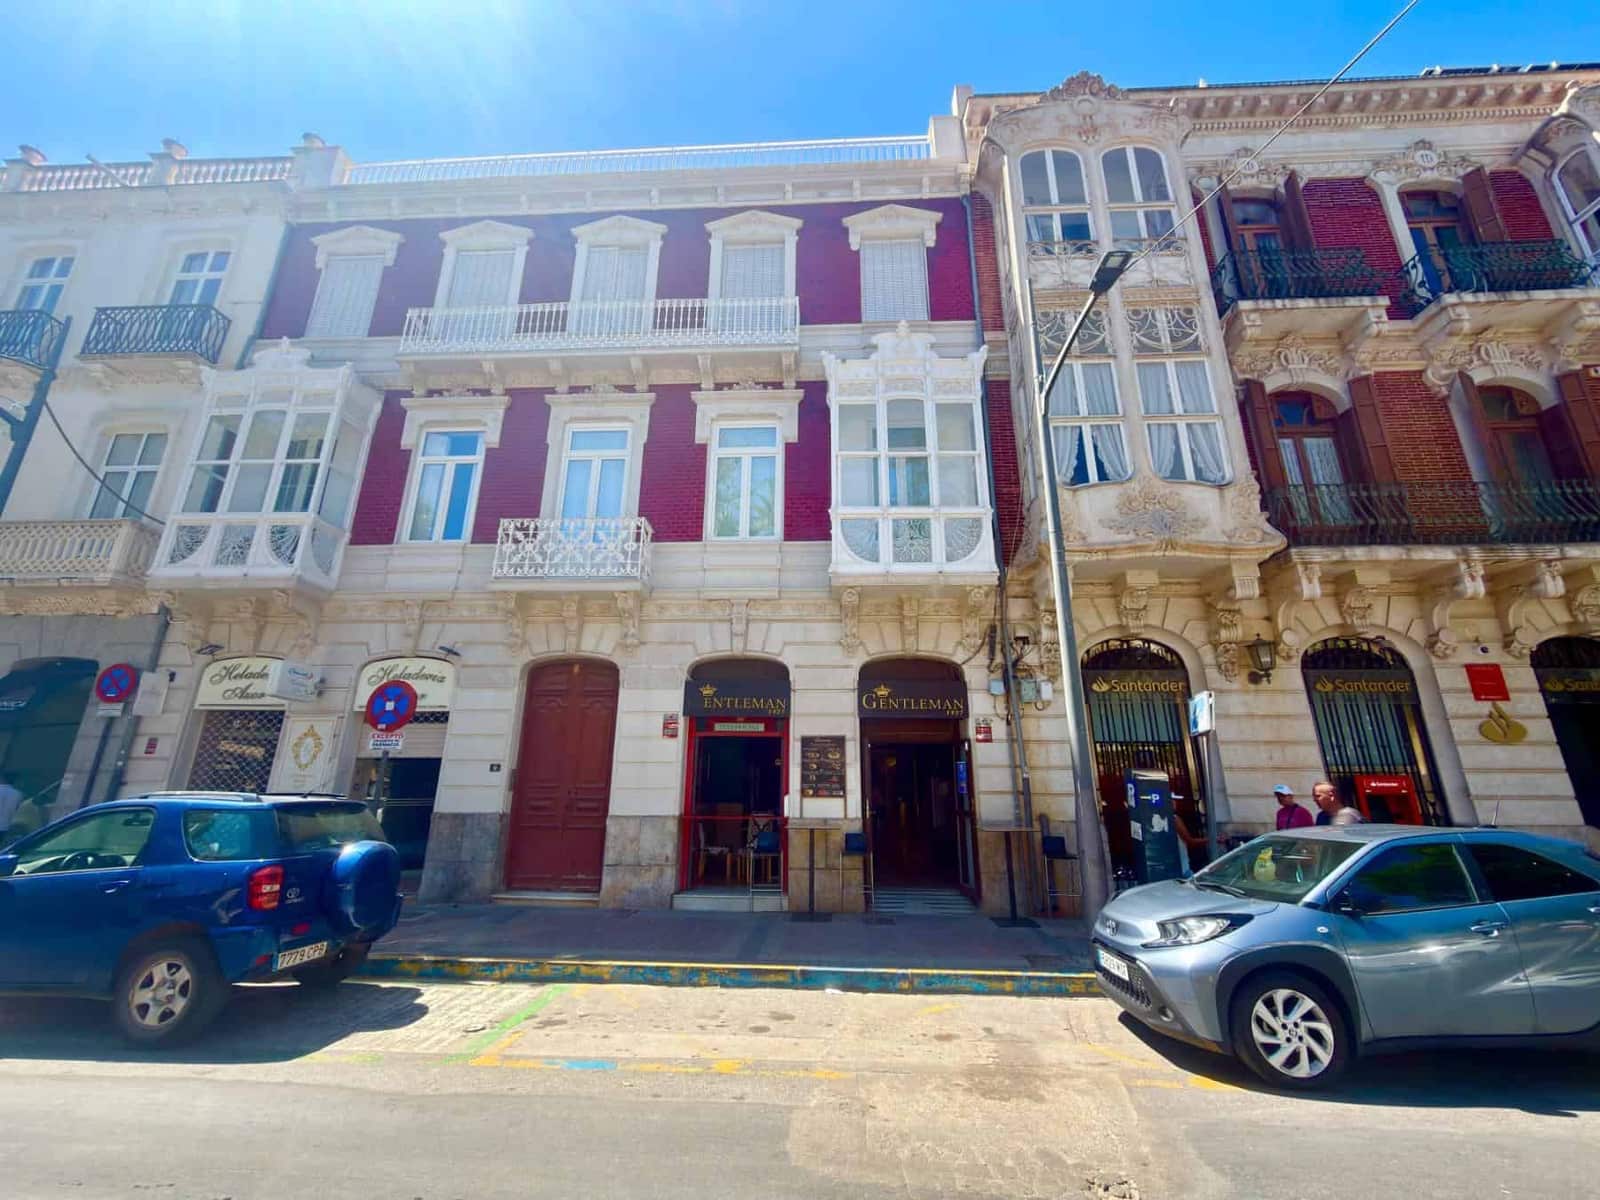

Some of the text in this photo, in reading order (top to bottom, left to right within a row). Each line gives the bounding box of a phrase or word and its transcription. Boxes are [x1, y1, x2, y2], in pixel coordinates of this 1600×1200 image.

[1111, 680, 1185, 692] Santander
[1335, 680, 1410, 692] Santander
[862, 694, 963, 710] GENTLEMAN
